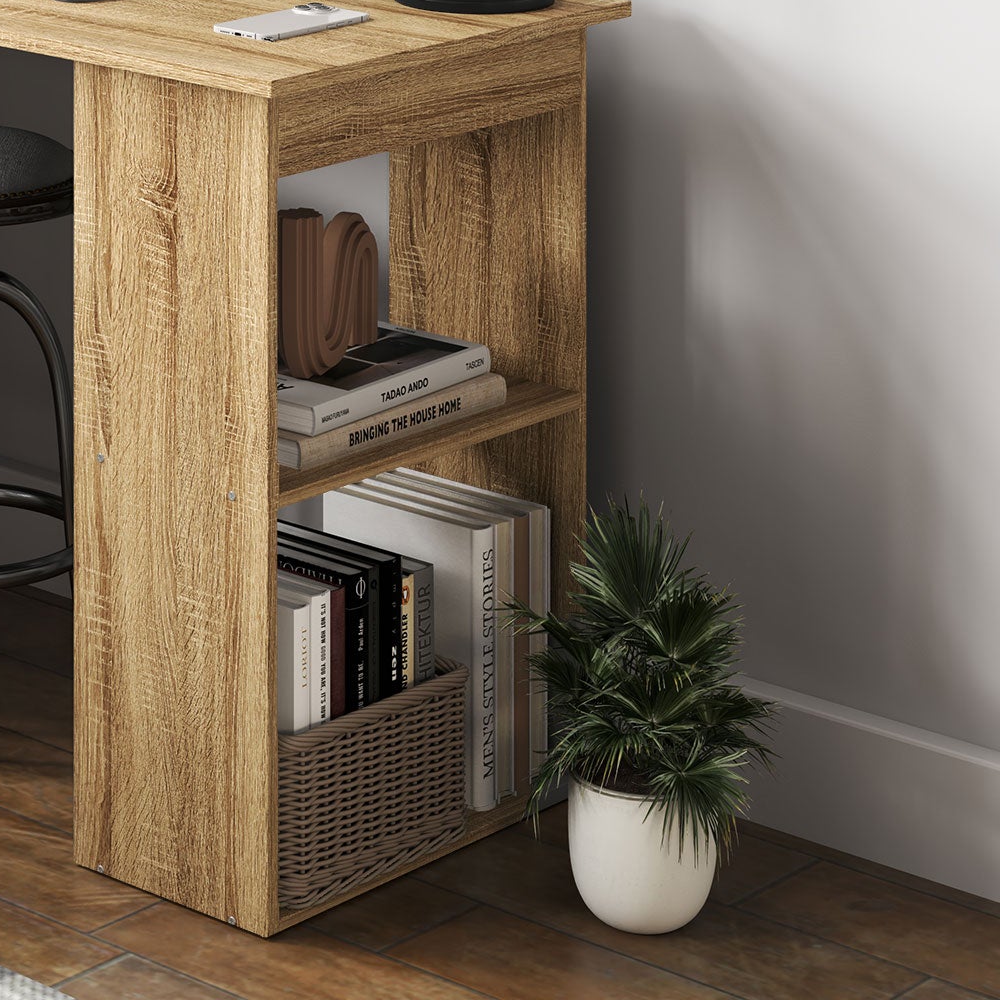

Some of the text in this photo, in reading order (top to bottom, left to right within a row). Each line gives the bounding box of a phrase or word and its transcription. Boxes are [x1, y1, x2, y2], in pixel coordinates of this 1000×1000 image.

[349, 397, 462, 447] BRINGING THE HOUSE HOME
[381, 377, 429, 403] TADAO ANDO
[418, 583, 432, 680] HITEKTUR
[482, 549, 495, 780] MEN'S STYLE STORIES
